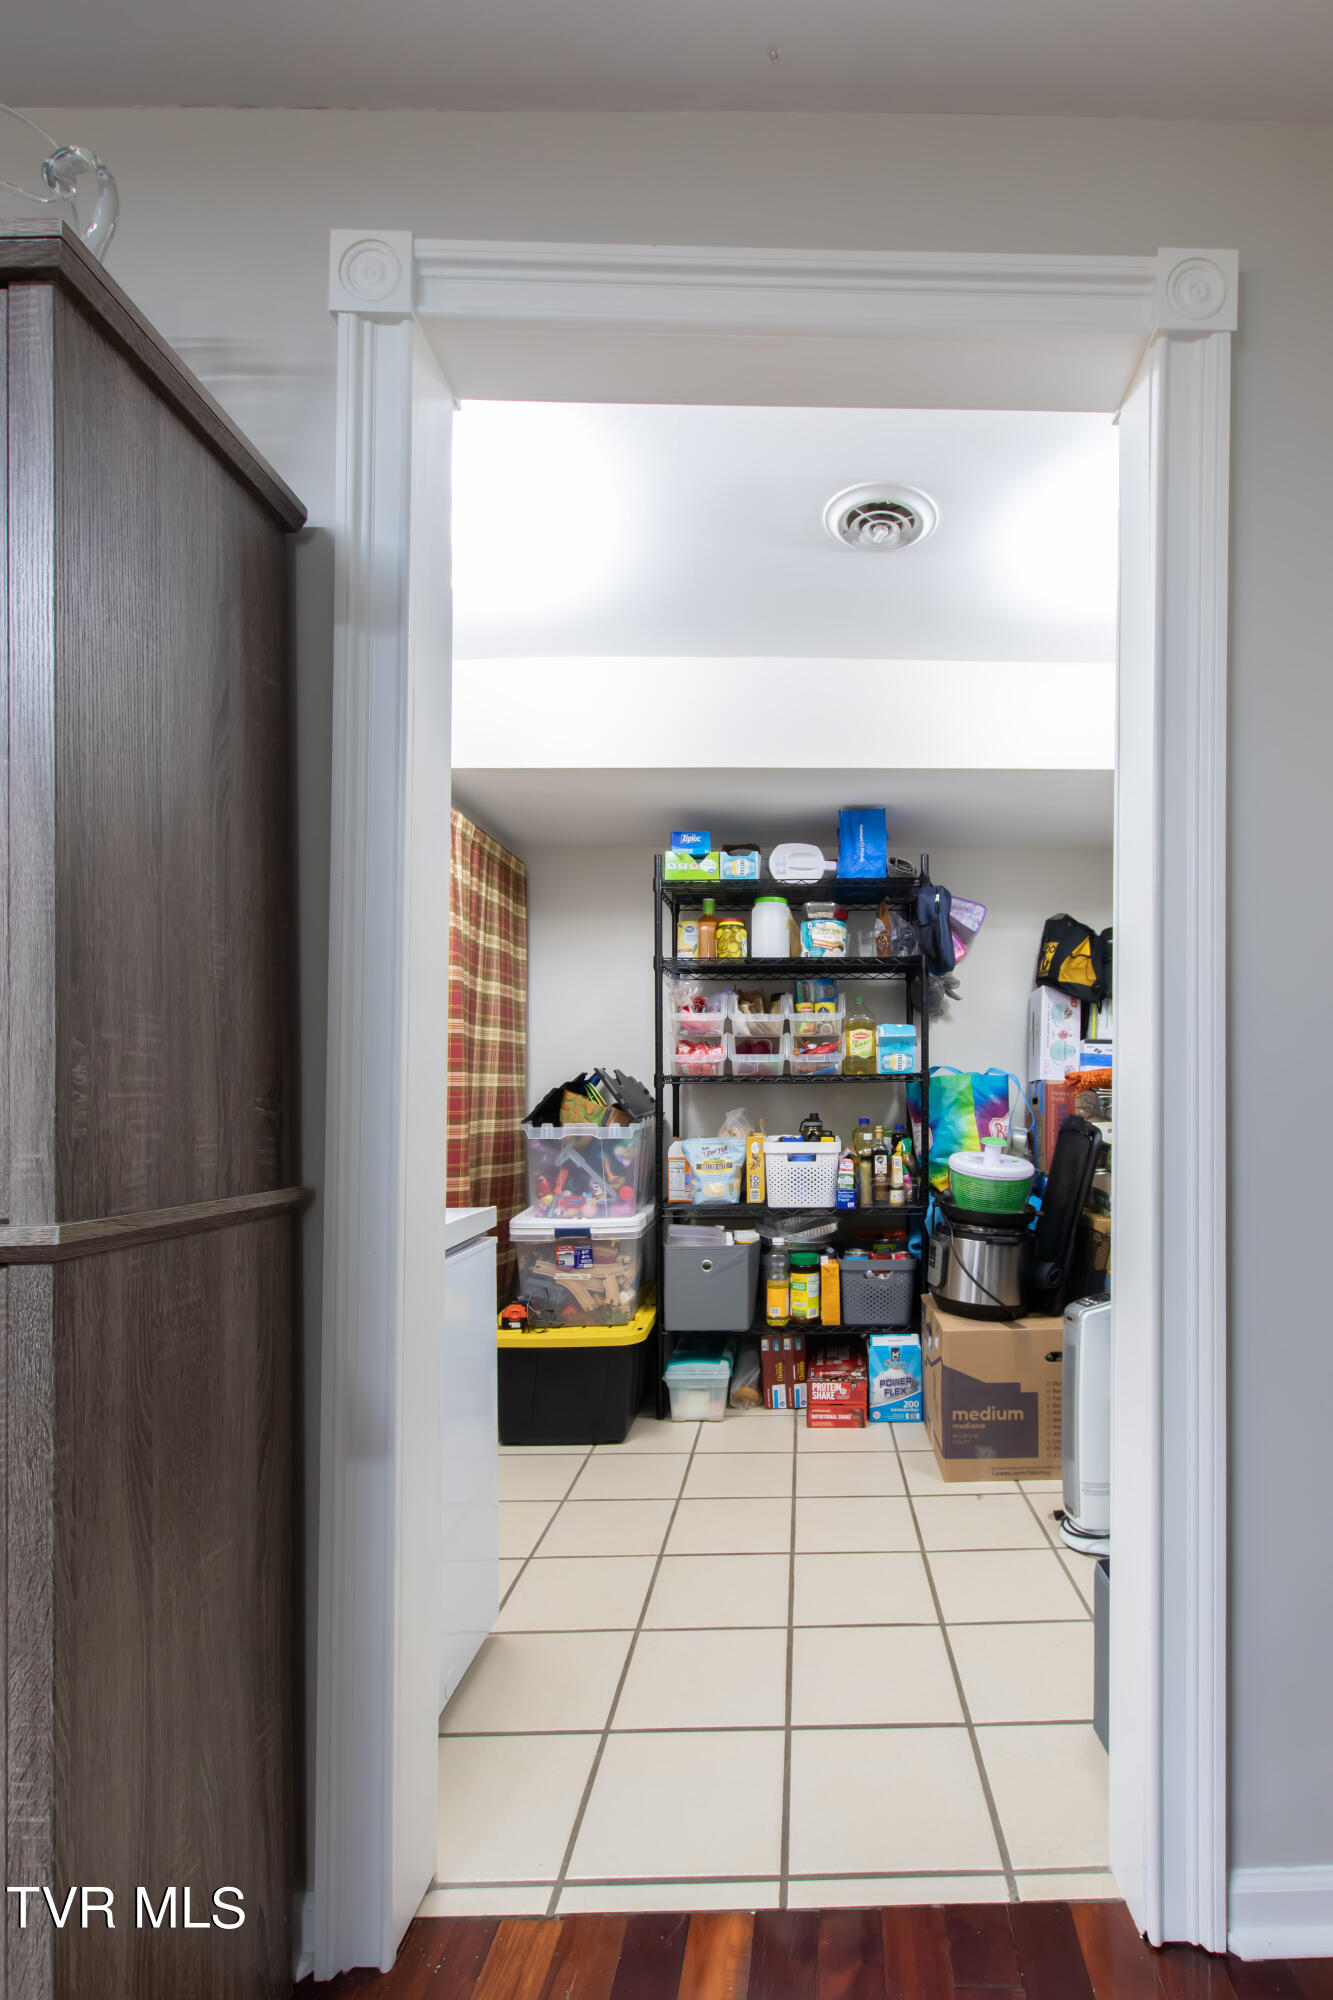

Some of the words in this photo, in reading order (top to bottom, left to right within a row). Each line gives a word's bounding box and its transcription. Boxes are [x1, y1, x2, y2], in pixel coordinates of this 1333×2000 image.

[681, 834, 702, 843] Ziploc
[812, 1382, 842, 1391] PROTEIN
[879, 1376, 912, 1388] POWER
[812, 1391, 836, 1400] SHAKE
[884, 1387, 907, 1397] FLEX
[903, 1400, 920, 1409] 200
[951, 1405, 1024, 1421] medium
[951, 1422, 987, 1430] mediano
